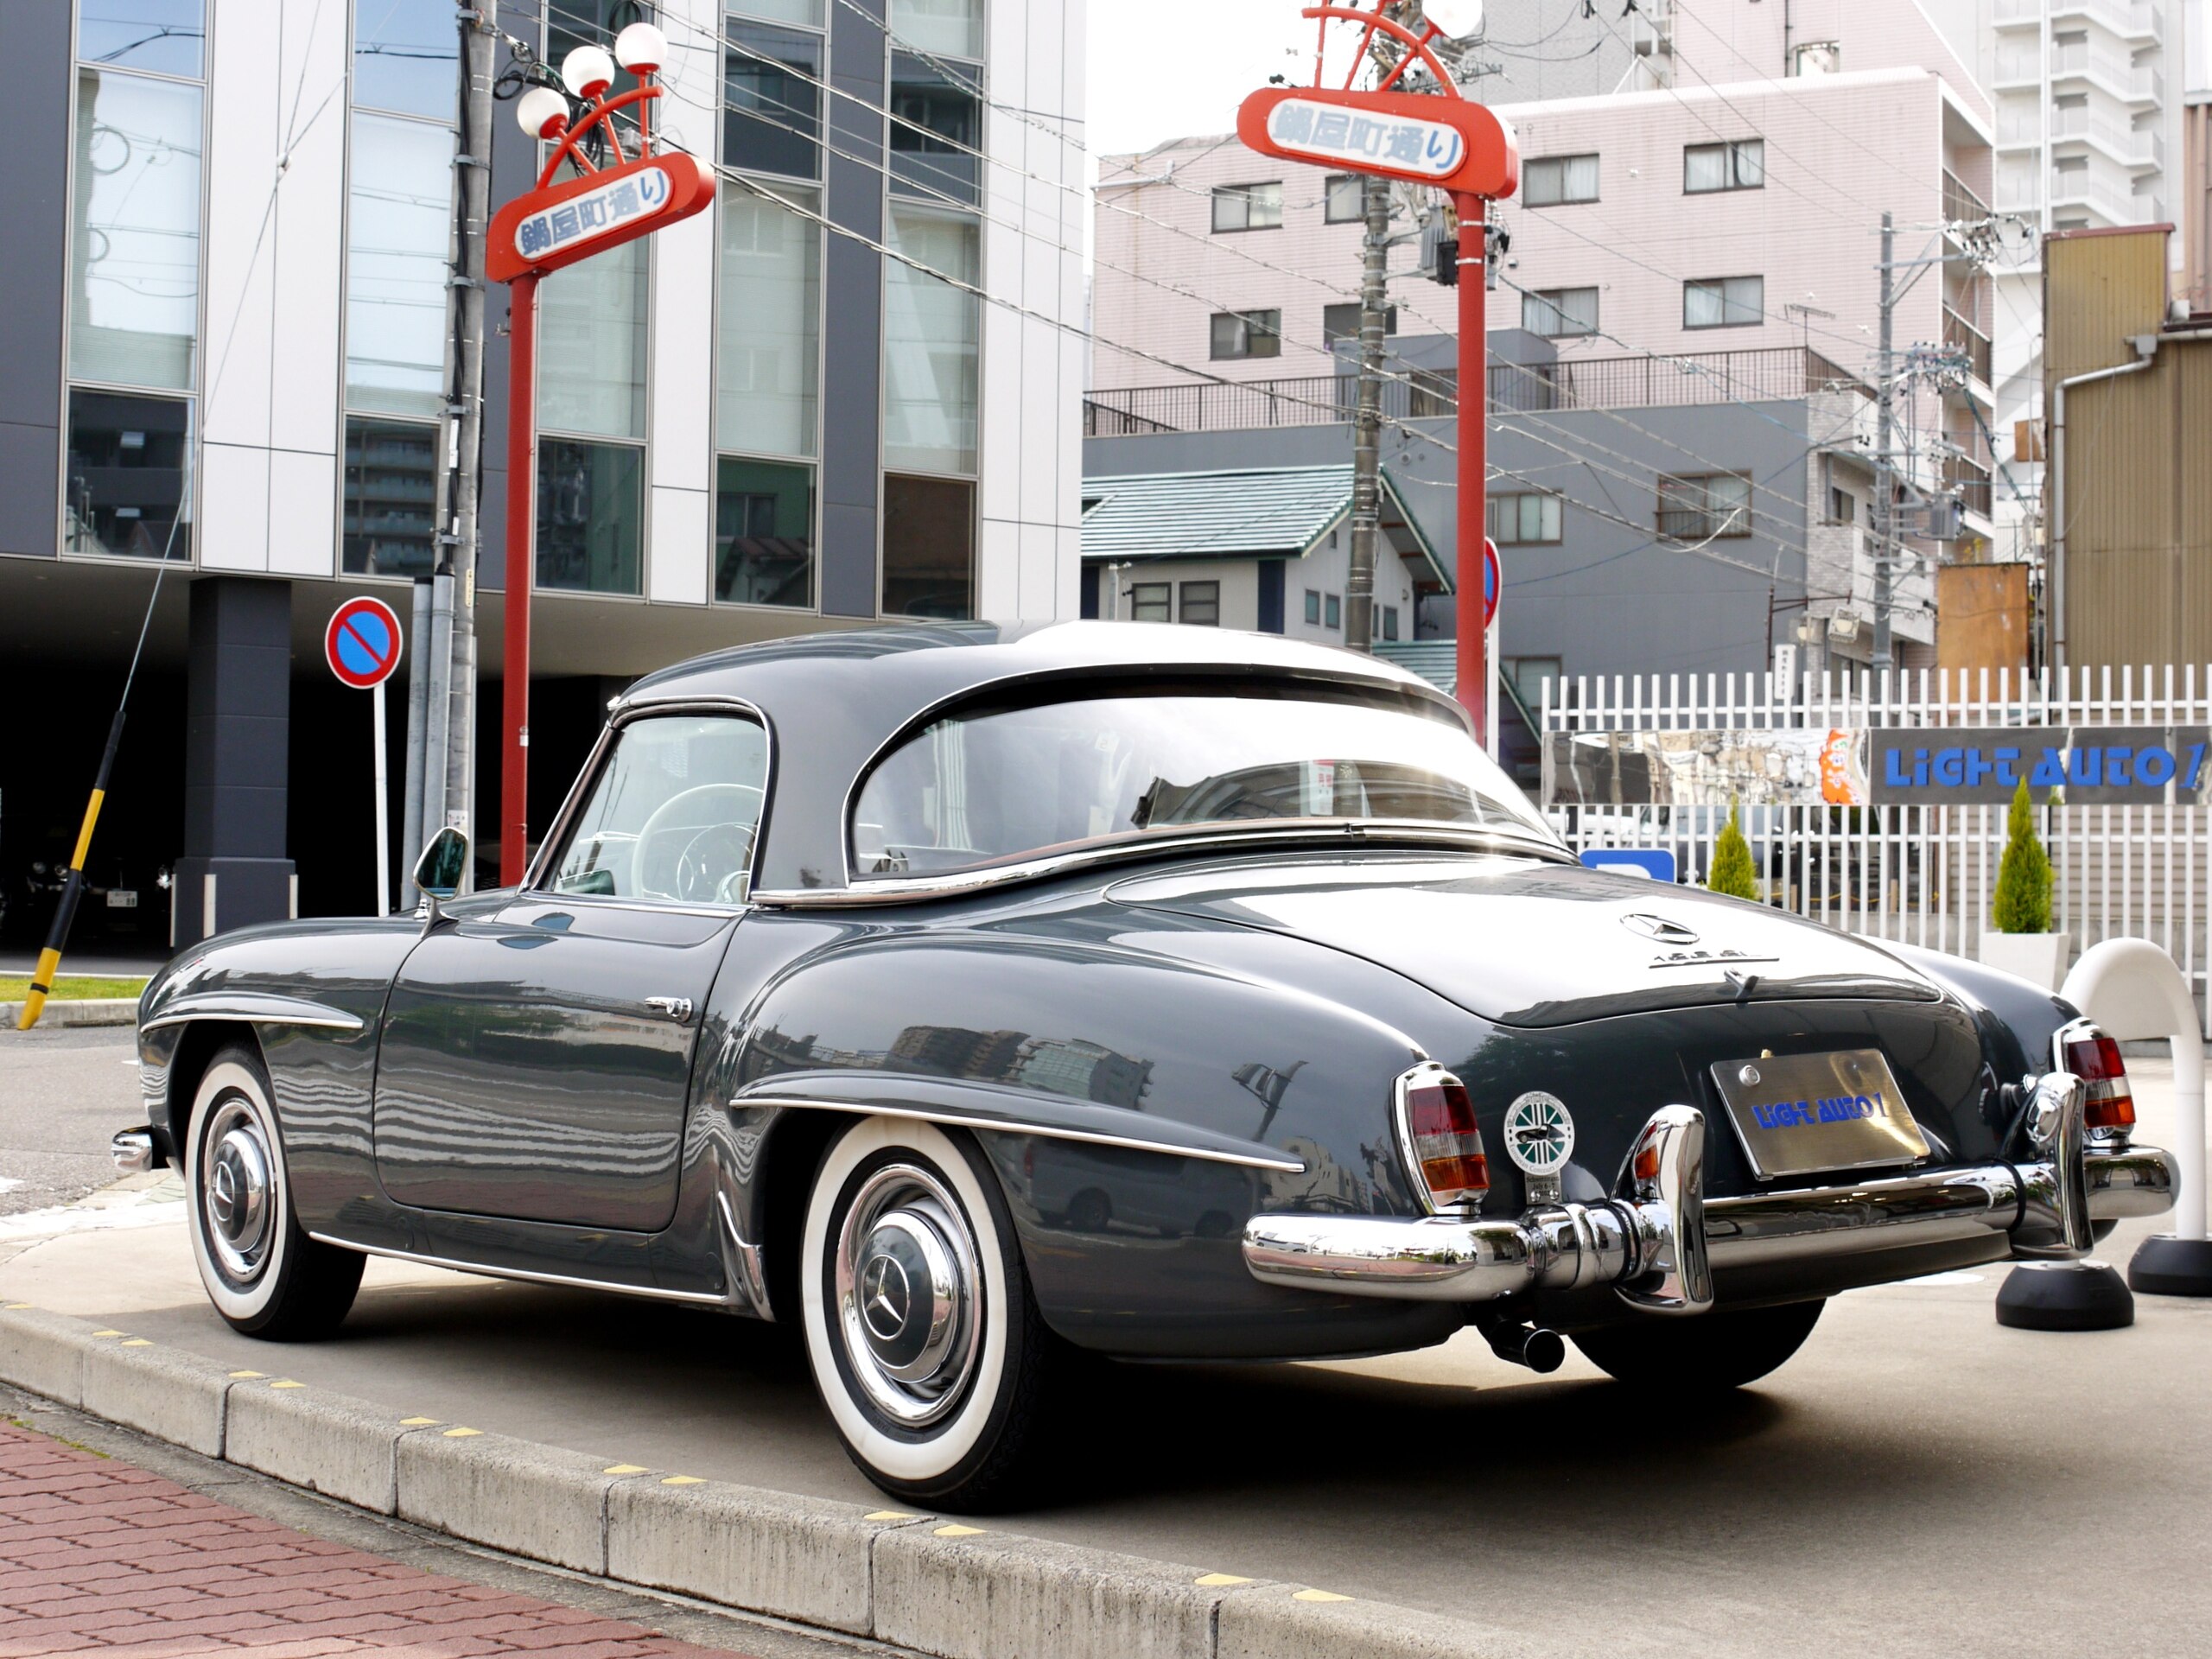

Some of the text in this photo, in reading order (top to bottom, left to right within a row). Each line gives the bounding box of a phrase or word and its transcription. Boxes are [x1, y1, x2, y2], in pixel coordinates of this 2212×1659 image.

[520, 169, 665, 256] 鍋屋町通り
